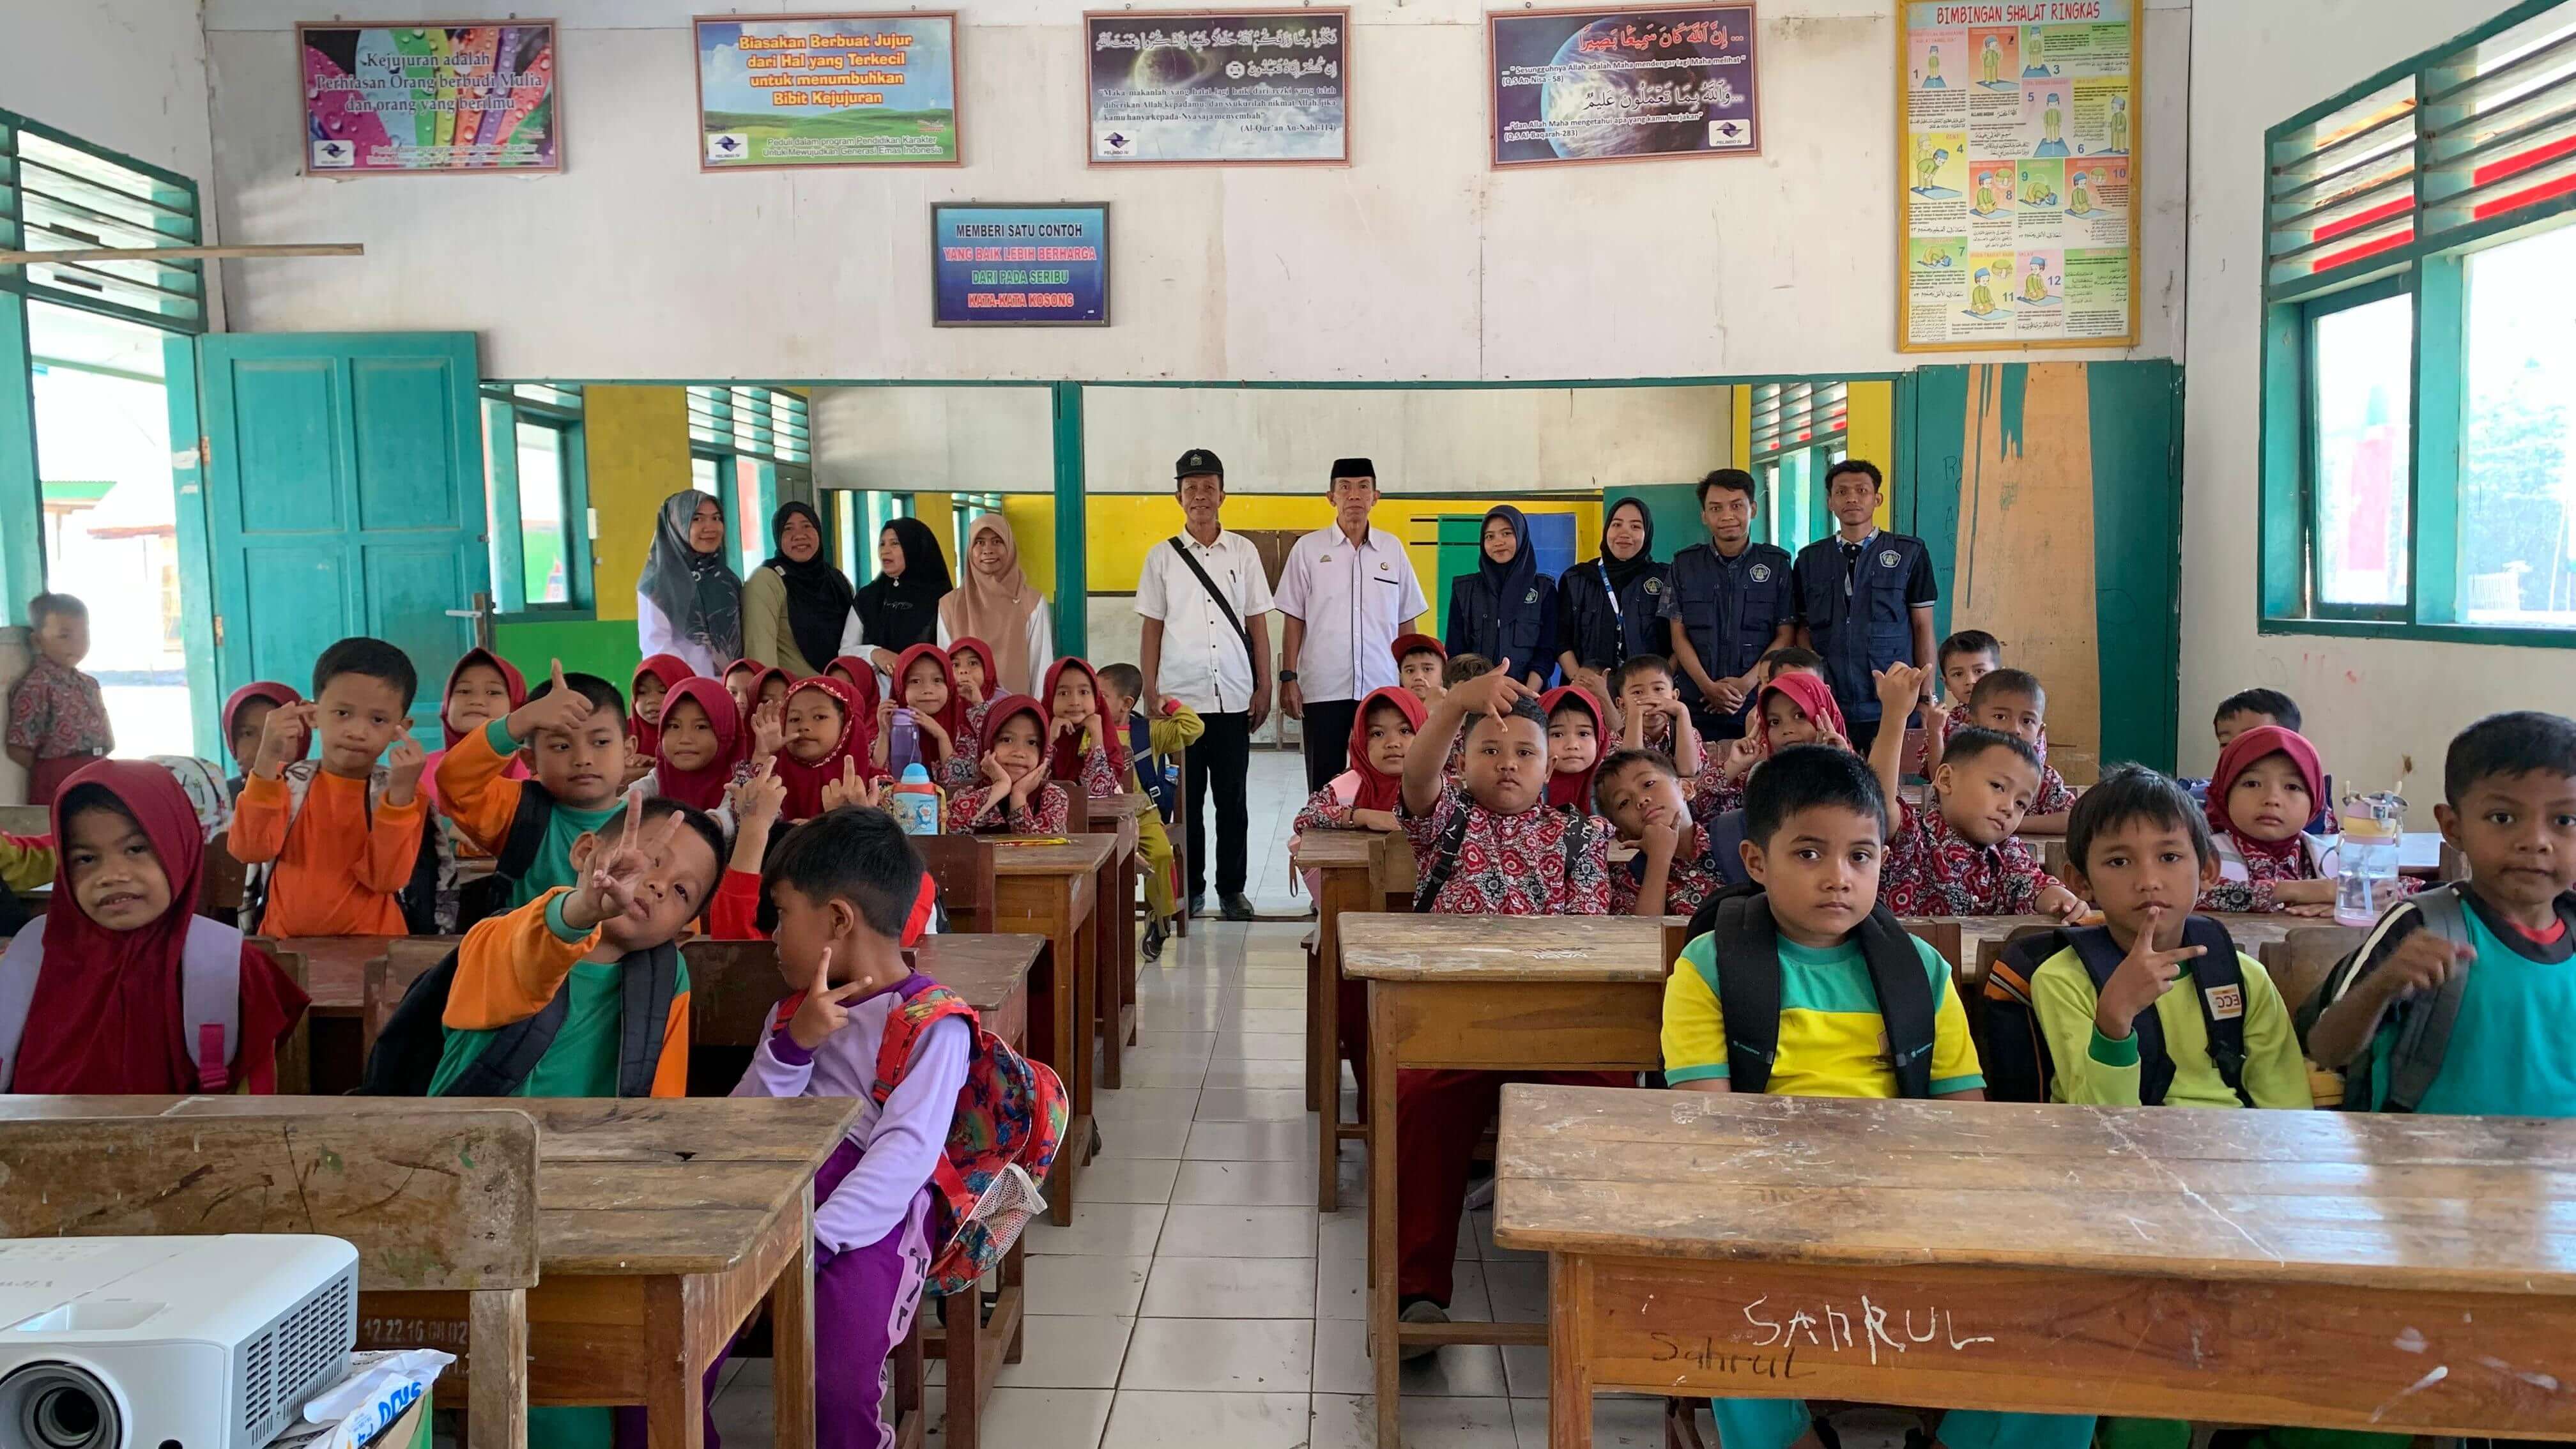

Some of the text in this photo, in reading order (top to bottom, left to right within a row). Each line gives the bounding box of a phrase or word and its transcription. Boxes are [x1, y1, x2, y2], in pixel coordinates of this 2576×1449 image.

[1937, 1, 2100, 24] BIMBINGAN SHALAT RINGKAS
[739, 33, 912, 50] Biasakan Berbuat Jujur
[367, 52, 490, 69] Kejujuran adalah
[747, 51, 906, 70] dari Hal yang Terkecil
[1516, 65, 1565, 74] Sesungguhnya
[1635, 59, 1675, 68] mendengar
[1676, 57, 1690, 67] lagi
[1713, 56, 1740, 64] melihat
[1913, 68, 1919, 79] 1
[2053, 65, 2060, 75] 3
[316, 72, 542, 93] Perhiasan Orang berbudi Mulia
[750, 70, 905, 86] untuk menumbuhkan
[1552, 75, 1564, 83] 58)
[1129, 88, 1167, 96] makanlah
[1252, 86, 1269, 95] dari
[2028, 92, 2034, 102] 5
[772, 90, 883, 107] Bibit Kejujuran
[346, 96, 515, 115] dan orang yang berilmu
[1529, 119, 1547, 128] Allah
[1570, 118, 1613, 128] mengetahui
[1614, 118, 1627, 126] apa
[1629, 116, 1646, 125] yang
[767, 135, 937, 147] Peduli dalam program Pendidikan Karakter
[788, 148, 839, 158] Mewujudkan
[840, 147, 877, 155] Generasi
[903, 145, 943, 154] Indonesia
[1956, 144, 1964, 153] 4
[2078, 144, 2084, 154] 6
[2021, 171, 2028, 181] 9
[2113, 168, 2126, 178] 10
[2005, 190, 2012, 200] 8
[956, 224, 1082, 238] MEMBERI SATU CONTOH
[943, 247, 1097, 261] YANG BAIK LEBIH BERHARGA
[1958, 247, 1965, 257] 7
[972, 270, 1069, 284] DARI PADA SERIBU
[2047, 275, 2061, 286] 12
[968, 293, 1074, 308] KATA-KATA KOSONG
[2002, 292, 2014, 302] 11
